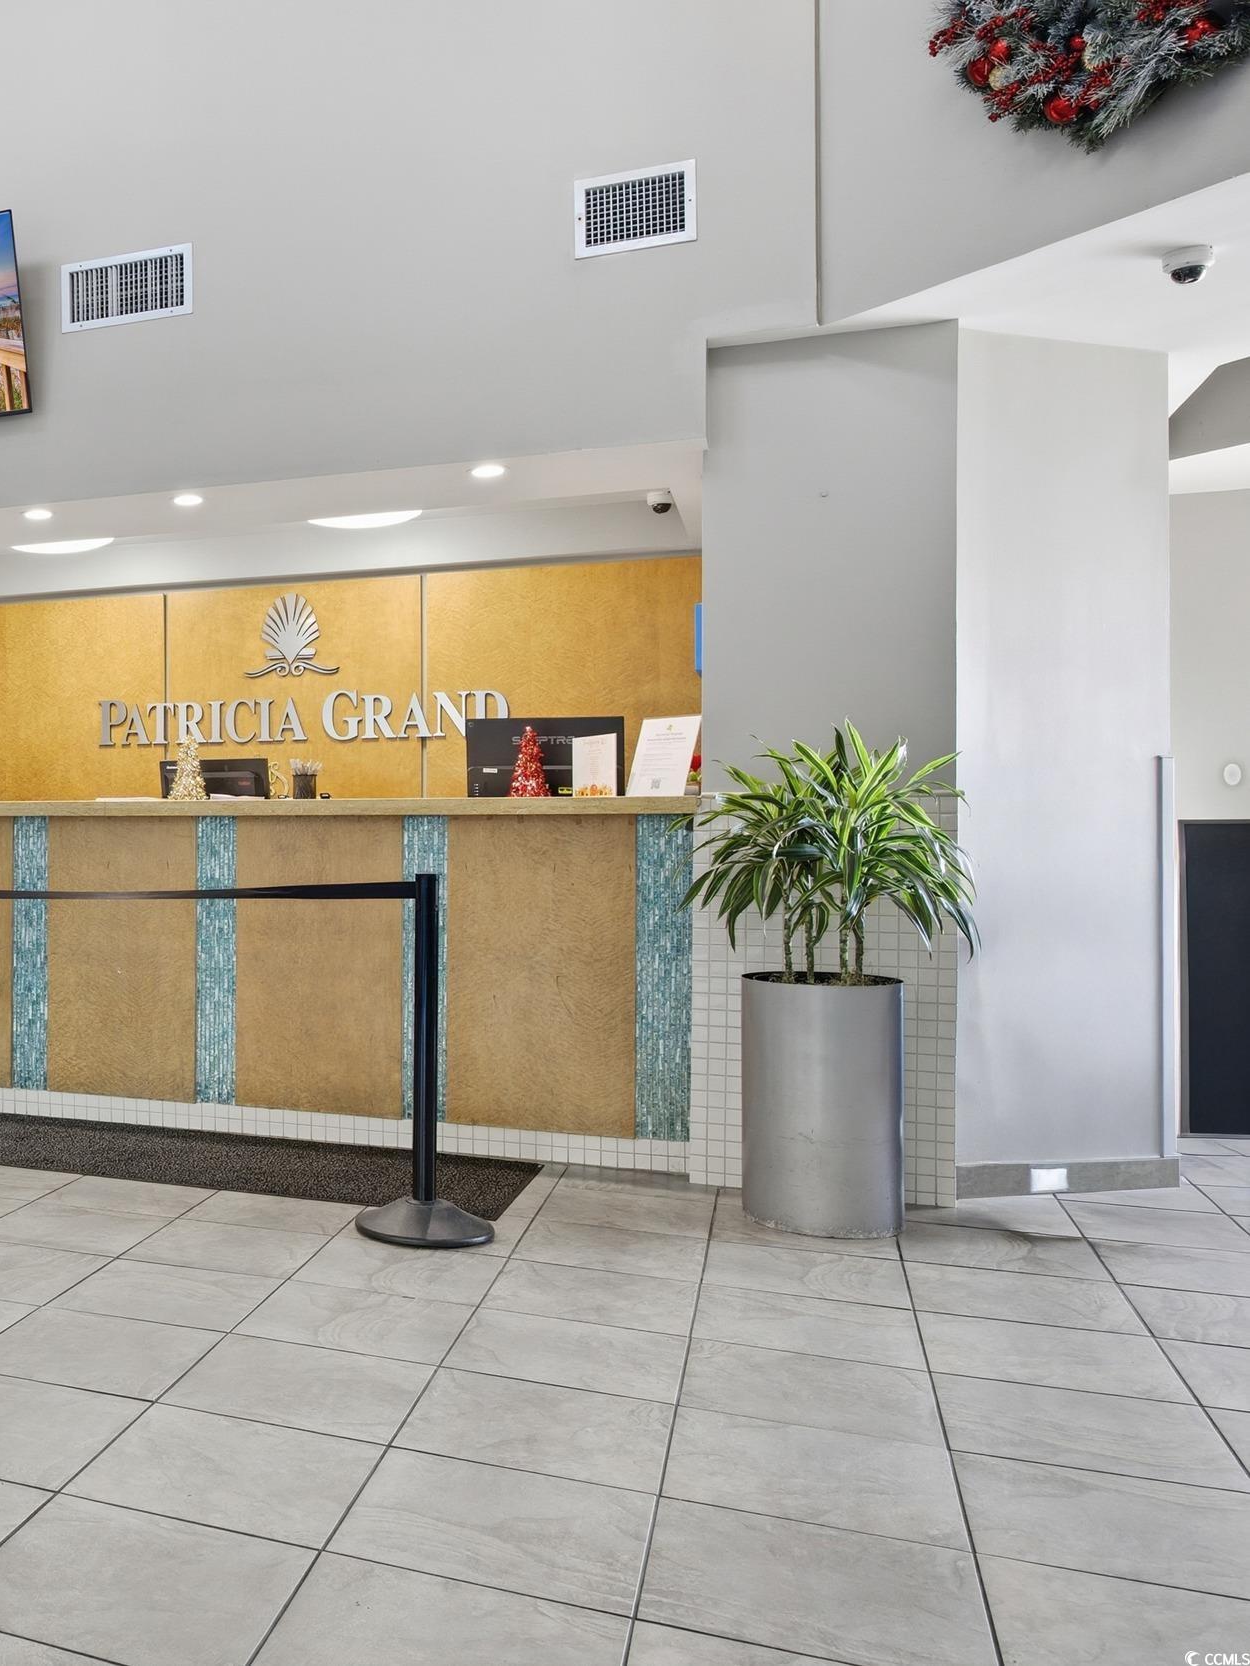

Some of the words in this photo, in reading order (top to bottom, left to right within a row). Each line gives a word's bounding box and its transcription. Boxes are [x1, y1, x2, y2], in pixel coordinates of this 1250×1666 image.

[98, 697, 309, 747] PATRICIA
[322, 689, 510, 742] GRAND
[511, 735, 574, 745] SPTRE
